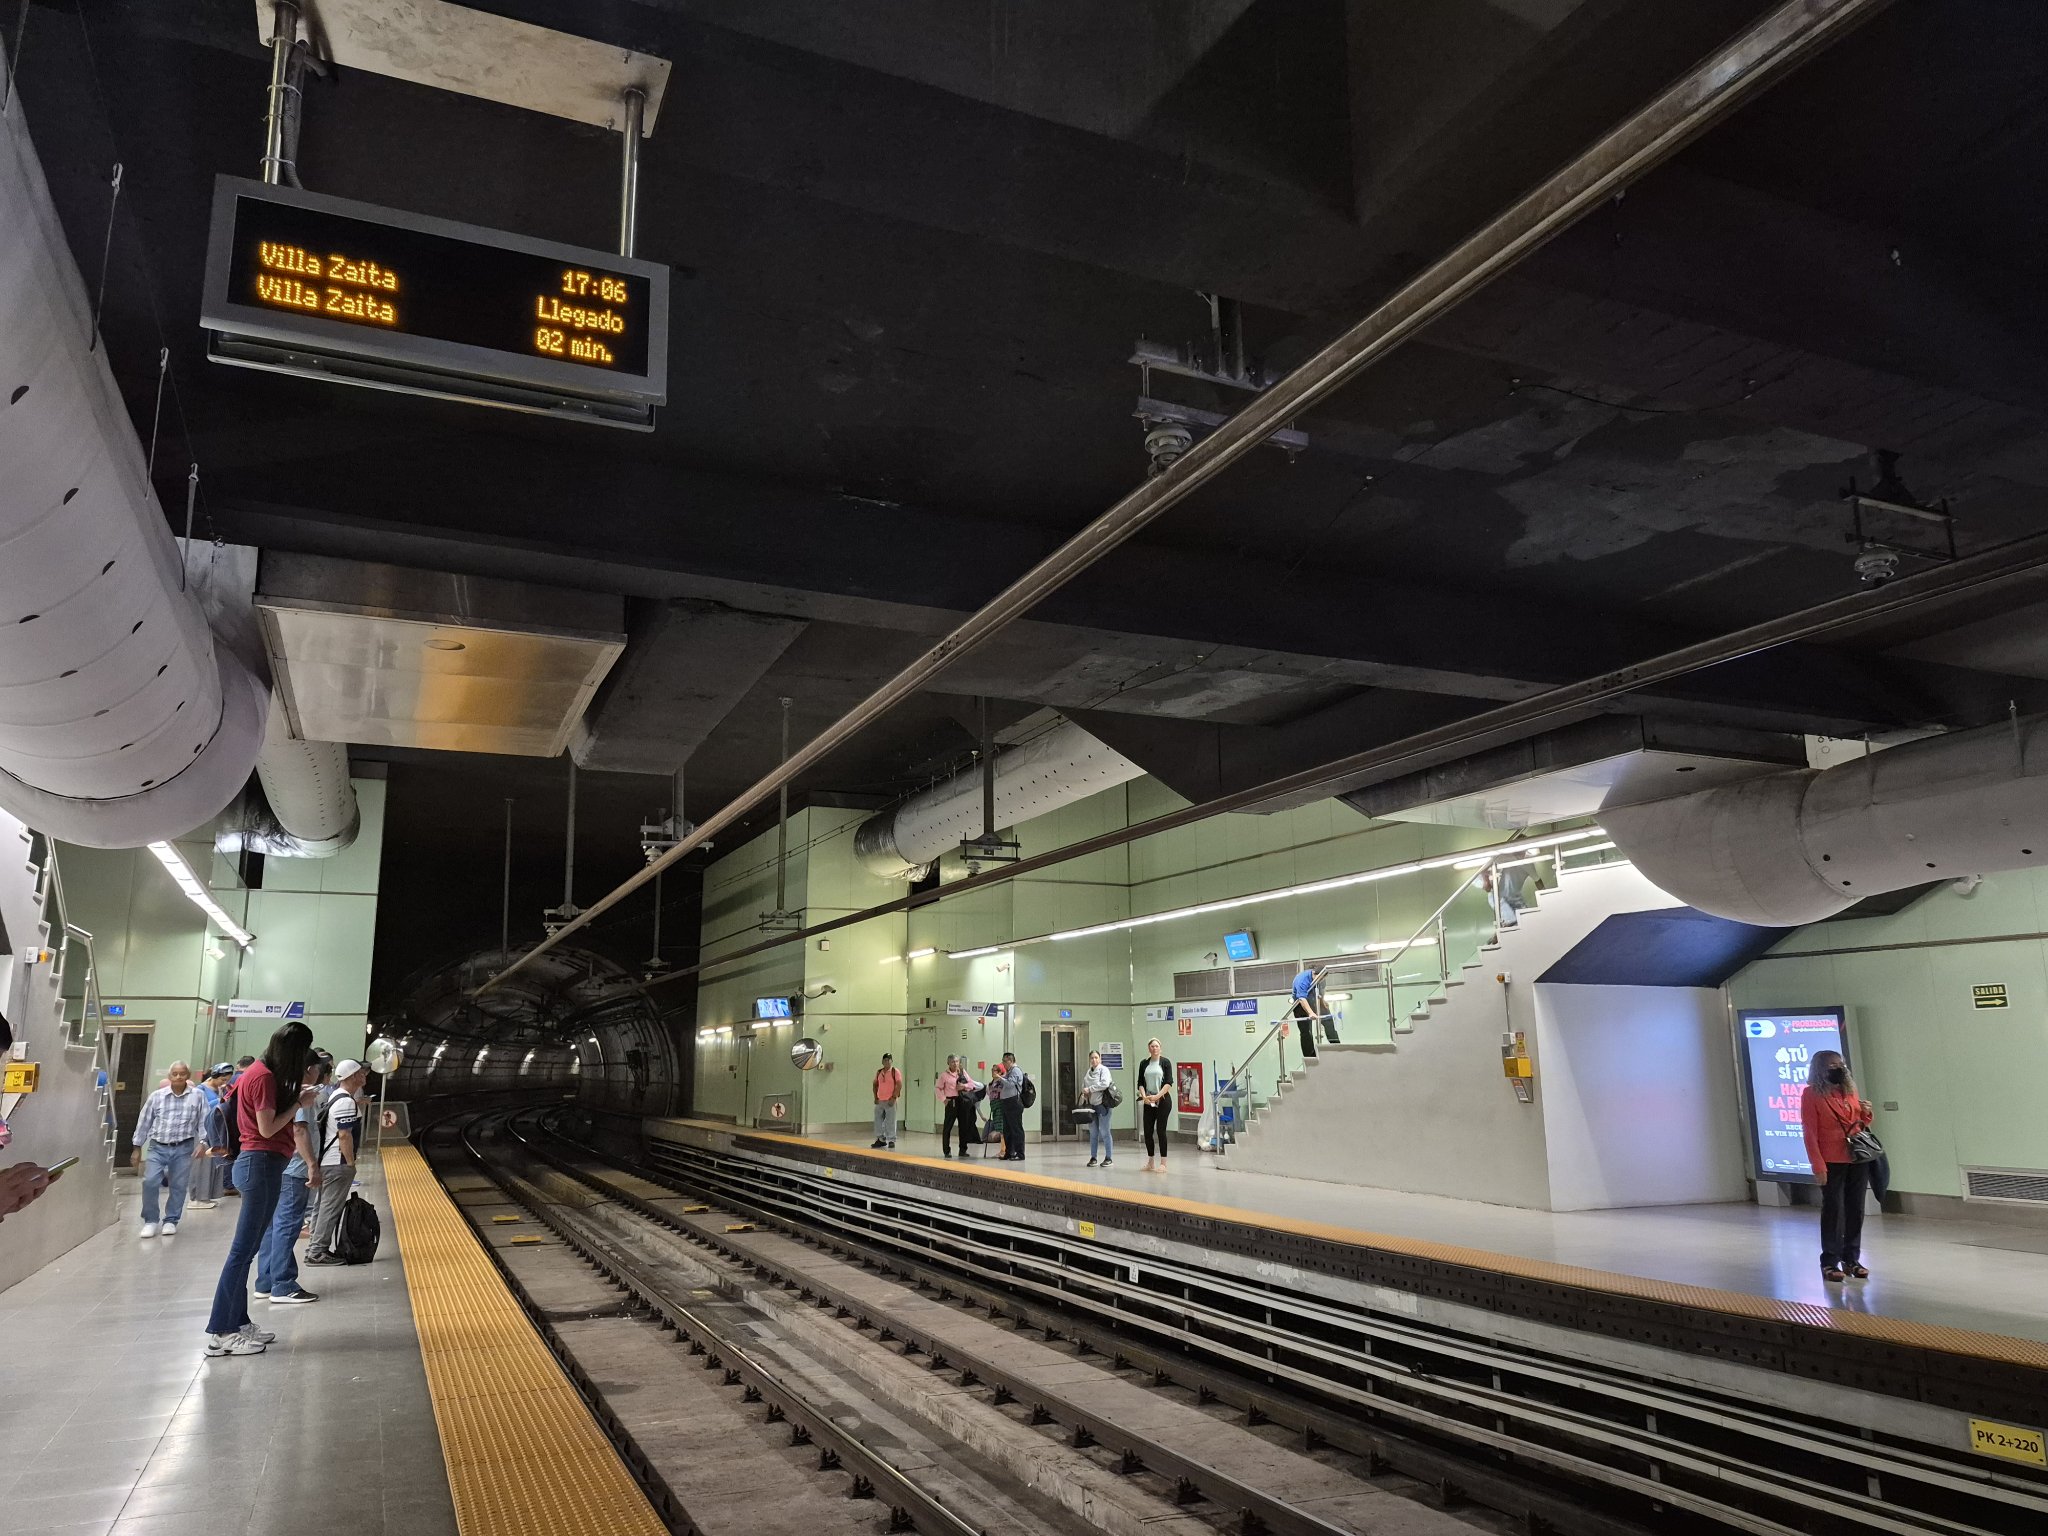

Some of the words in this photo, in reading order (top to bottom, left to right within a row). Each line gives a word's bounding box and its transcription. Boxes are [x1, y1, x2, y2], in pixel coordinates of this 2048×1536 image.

[260, 241, 321, 276] Villa
[328, 253, 398, 291] Zaita
[562, 270, 627, 303] 17:06
[256, 274, 318, 309] Villa
[325, 287, 395, 323] Zaita
[537, 295, 625, 333] Llegado
[536, 328, 564, 354] 02
[570, 336, 613, 363] min.
[1974, 986, 2005, 997] SALIDA
[1788, 1044, 1809, 1062] TÚ
[1779, 1064, 1791, 1080] SÍ
[1780, 1083, 1808, 1096] HAZ
[1768, 1096, 1786, 1109] LA
[1787, 1096, 1802, 1109] PR
[1977, 1430, 1995, 1445] PK
[1997, 1434, 2039, 1453] 2+220
